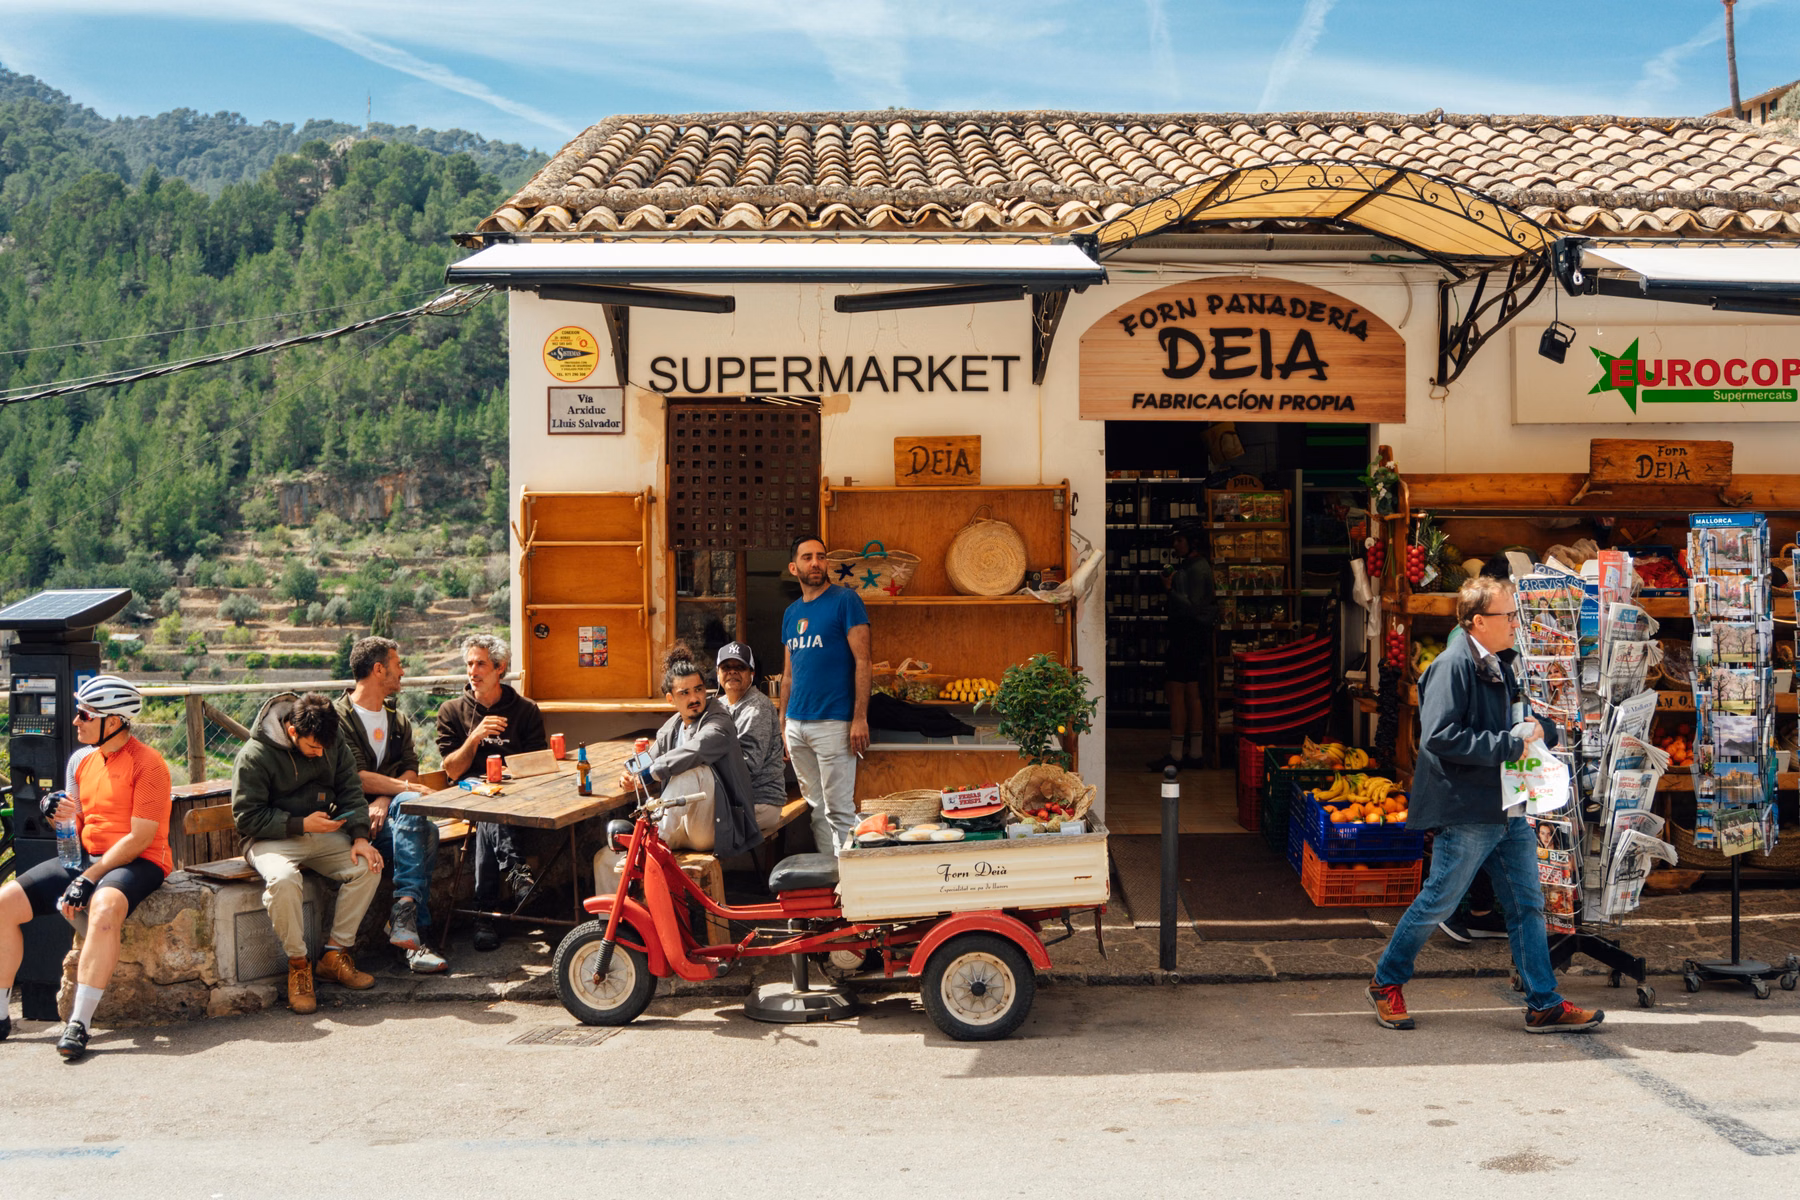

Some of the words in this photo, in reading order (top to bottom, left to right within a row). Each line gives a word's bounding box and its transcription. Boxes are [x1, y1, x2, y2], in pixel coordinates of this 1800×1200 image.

[1119, 296, 1197, 337] FORN
[1206, 293, 1370, 342] PANADERÍA
[1158, 327, 1329, 380] DEIA
[648, 354, 1021, 395] SUPERMARKET
[1279, 395, 1355, 411] PROPIA
[1713, 390, 1792, 402] Supermercats
[567, 406, 606, 415] Arxiduc
[578, 418, 621, 428] Salvador
[906, 444, 974, 477] DEIA
[1657, 446, 1688, 458] Forn
[1635, 454, 1691, 480] DEIA
[787, 634, 824, 650] TALIA
[936, 864, 969, 882] Forn
[974, 861, 1007, 877] Deià
